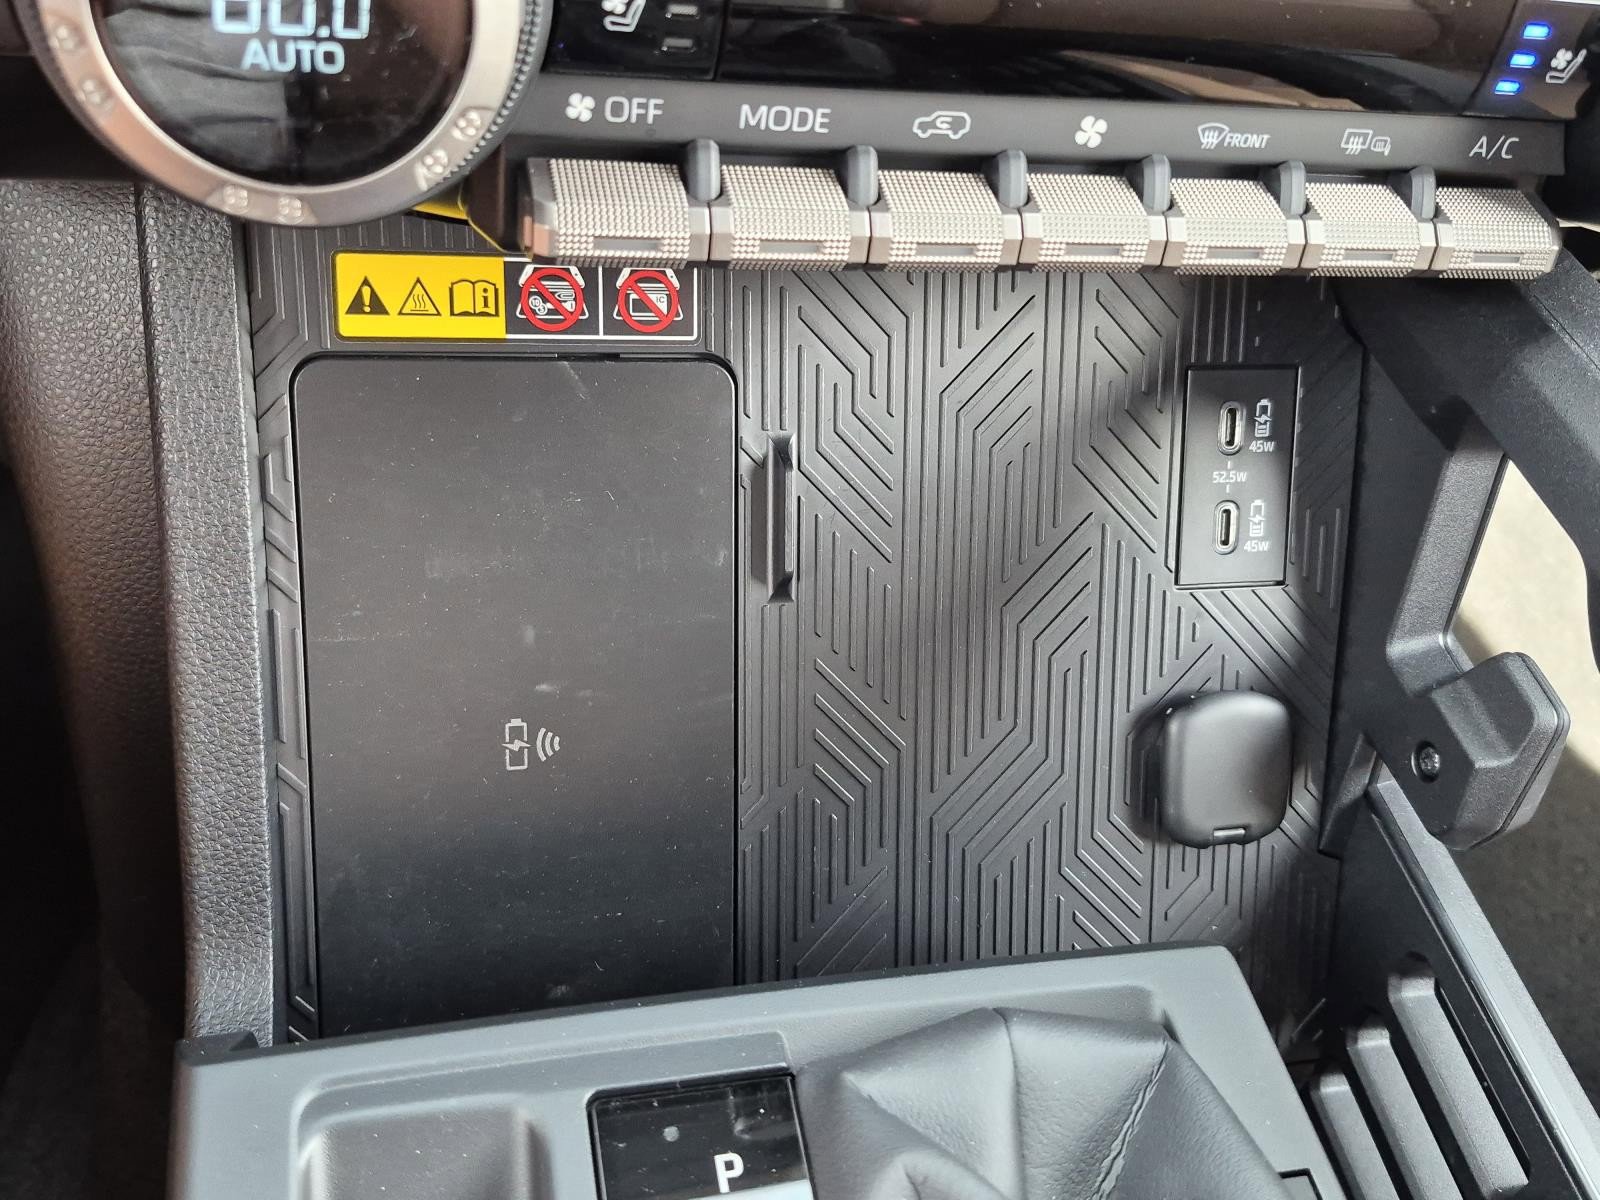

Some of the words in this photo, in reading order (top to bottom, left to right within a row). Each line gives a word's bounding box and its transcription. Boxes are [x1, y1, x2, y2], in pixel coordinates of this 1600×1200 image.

[241, 38, 345, 74] AUTO
[604, 96, 664, 124] OFF
[739, 104, 832, 133] MODE
[1224, 132, 1270, 149] FRONT
[1469, 135, 1520, 159] A/C
[1249, 440, 1275, 453] 45W
[1212, 471, 1247, 484] 52.5W
[1243, 541, 1269, 552] 45W
[714, 1152, 744, 1194] P
